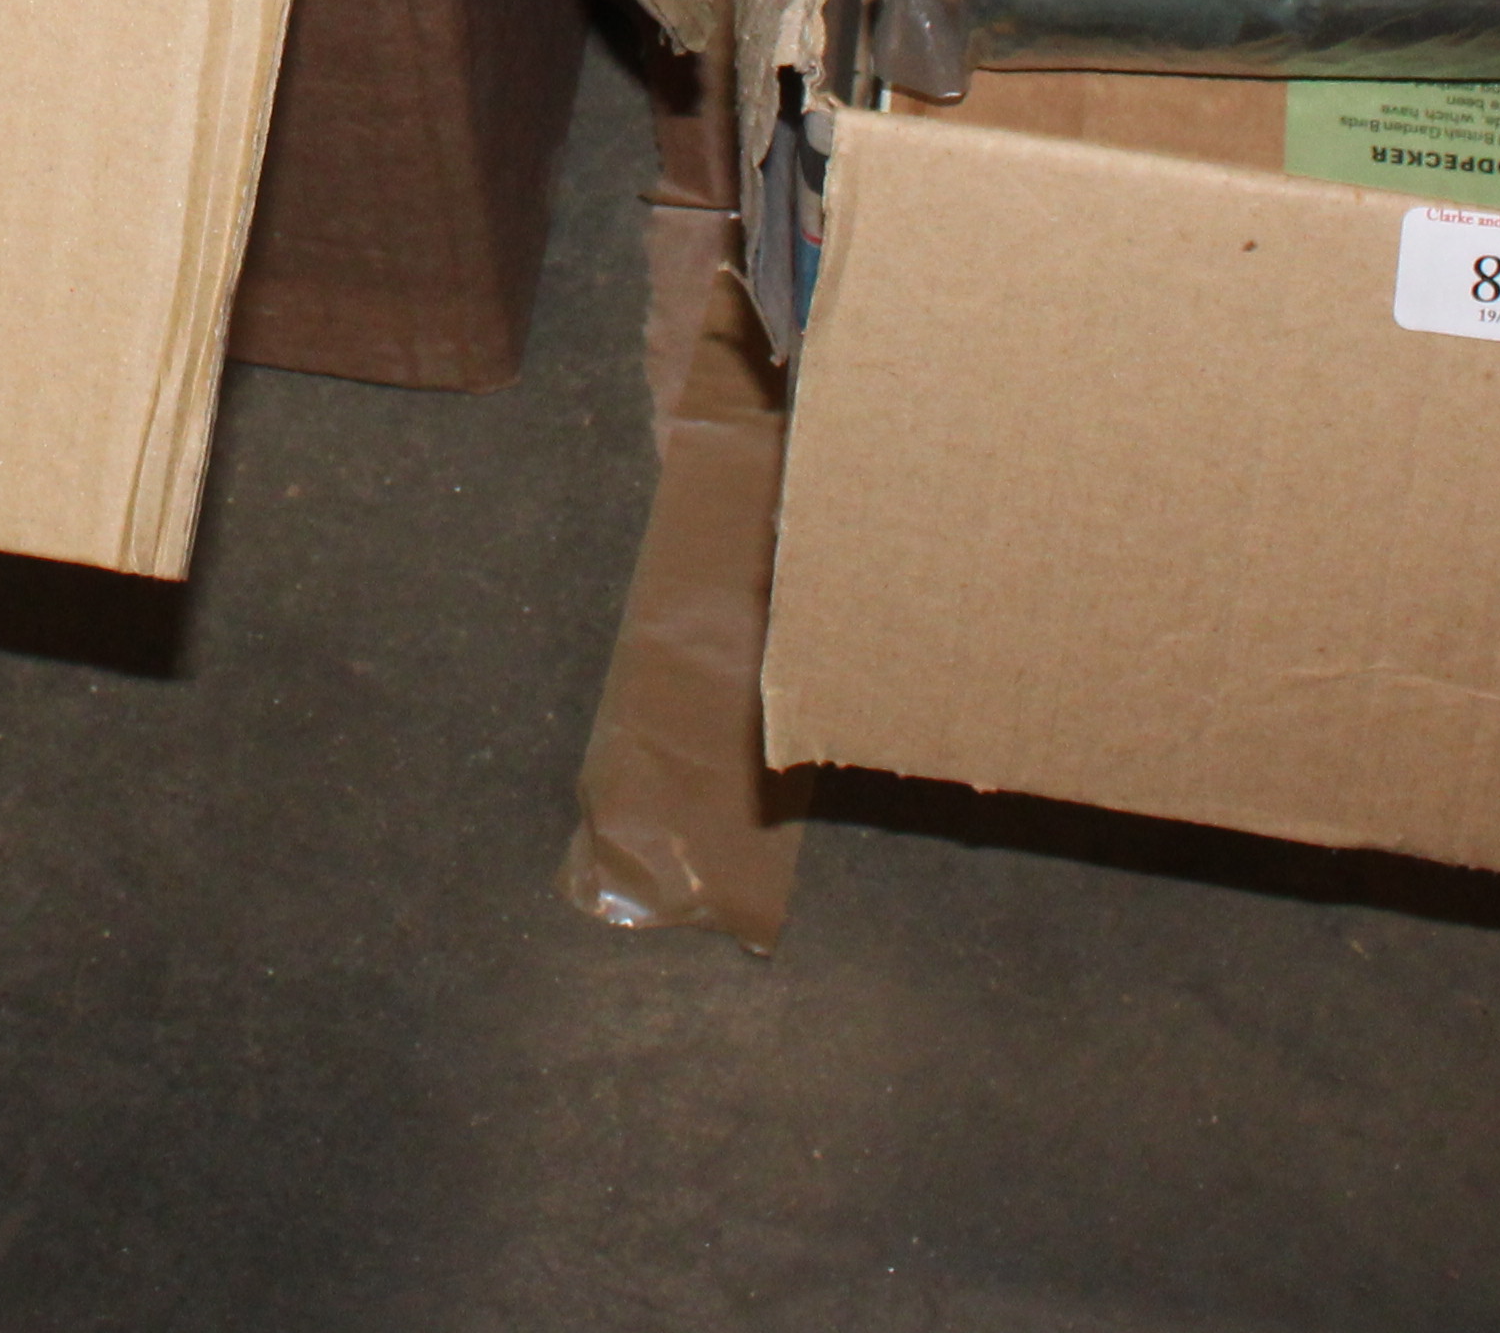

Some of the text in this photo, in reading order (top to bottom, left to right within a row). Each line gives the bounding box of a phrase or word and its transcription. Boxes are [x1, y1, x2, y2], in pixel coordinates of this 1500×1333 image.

[1444, 96, 1485, 111] been
[1379, 105, 1420, 120] have
[1422, 109, 1475, 127] which
[1338, 116, 1381, 132] Birds
[1382, 122, 1442, 139] Garden
[1442, 128, 1495, 145] British
[1425, 206, 1474, 227] Clarke
